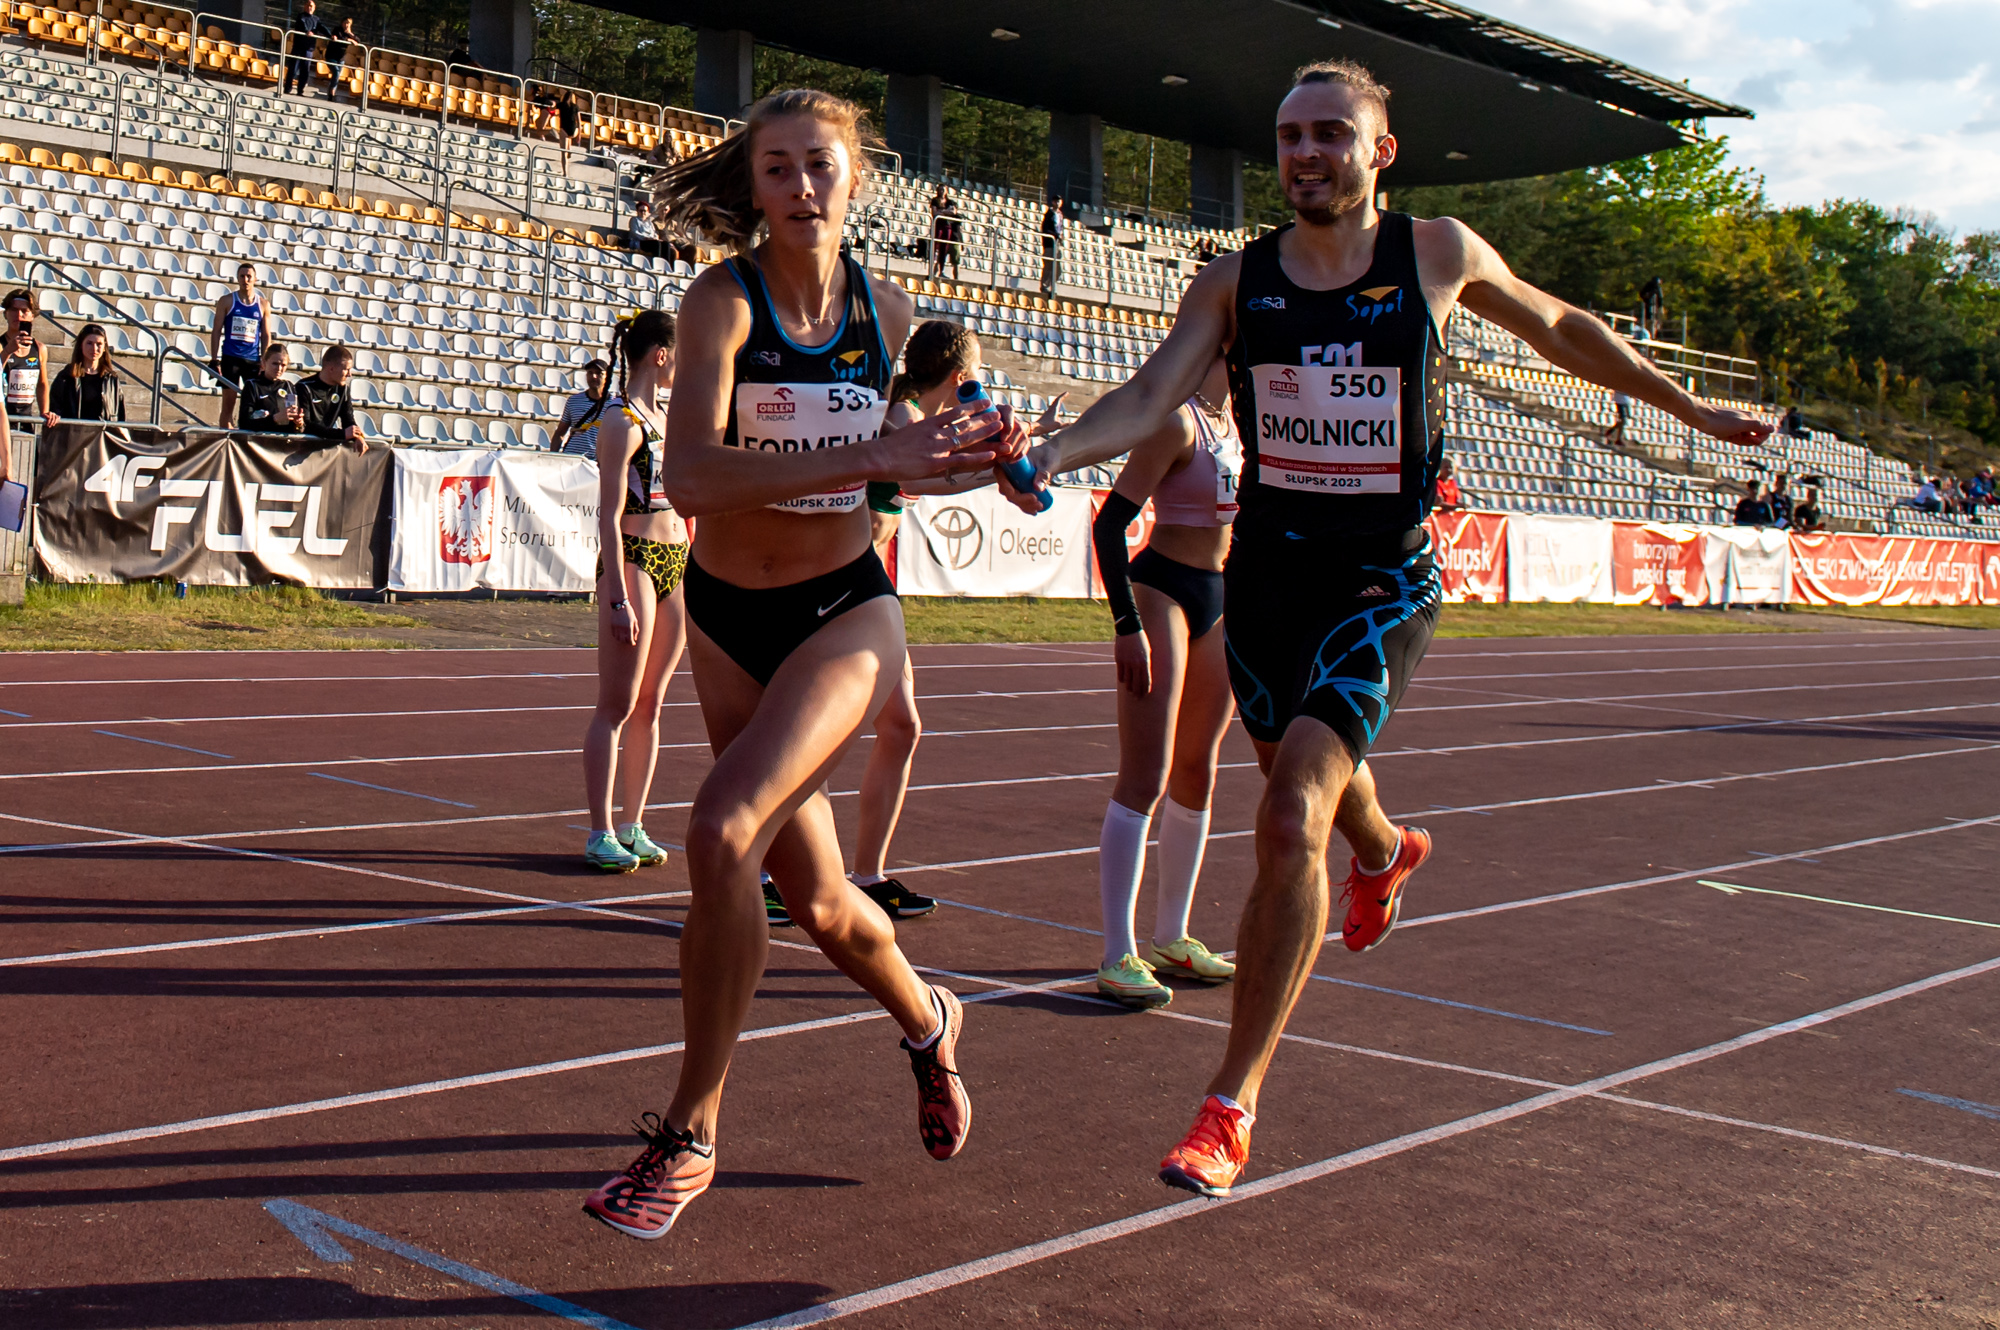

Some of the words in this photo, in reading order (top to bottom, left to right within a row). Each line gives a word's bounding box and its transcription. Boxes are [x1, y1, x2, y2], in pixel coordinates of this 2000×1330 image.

[1346, 289, 1404, 325] Sopot
[1270, 382, 1298, 392] ORLEN
[1270, 391, 1299, 400] FUNDACJA
[1330, 374, 1386, 398] 550
[759, 404, 794, 412] ORLEN
[1262, 413, 1395, 447] SMOLNICKI
[1318, 464, 1339, 472] Polski
[1348, 465, 1388, 473] Sztafetach
[1285, 474, 1328, 487] SŁUPSK
[1330, 477, 1362, 488] 2023
[828, 495, 857, 508] 2023
[150, 479, 349, 556] FUEL
[500, 526, 556, 549] Sportu
[999, 528, 1064, 561] Okęcie
[1438, 536, 1491, 578] Słupsk
[1633, 563, 1663, 589] polski
